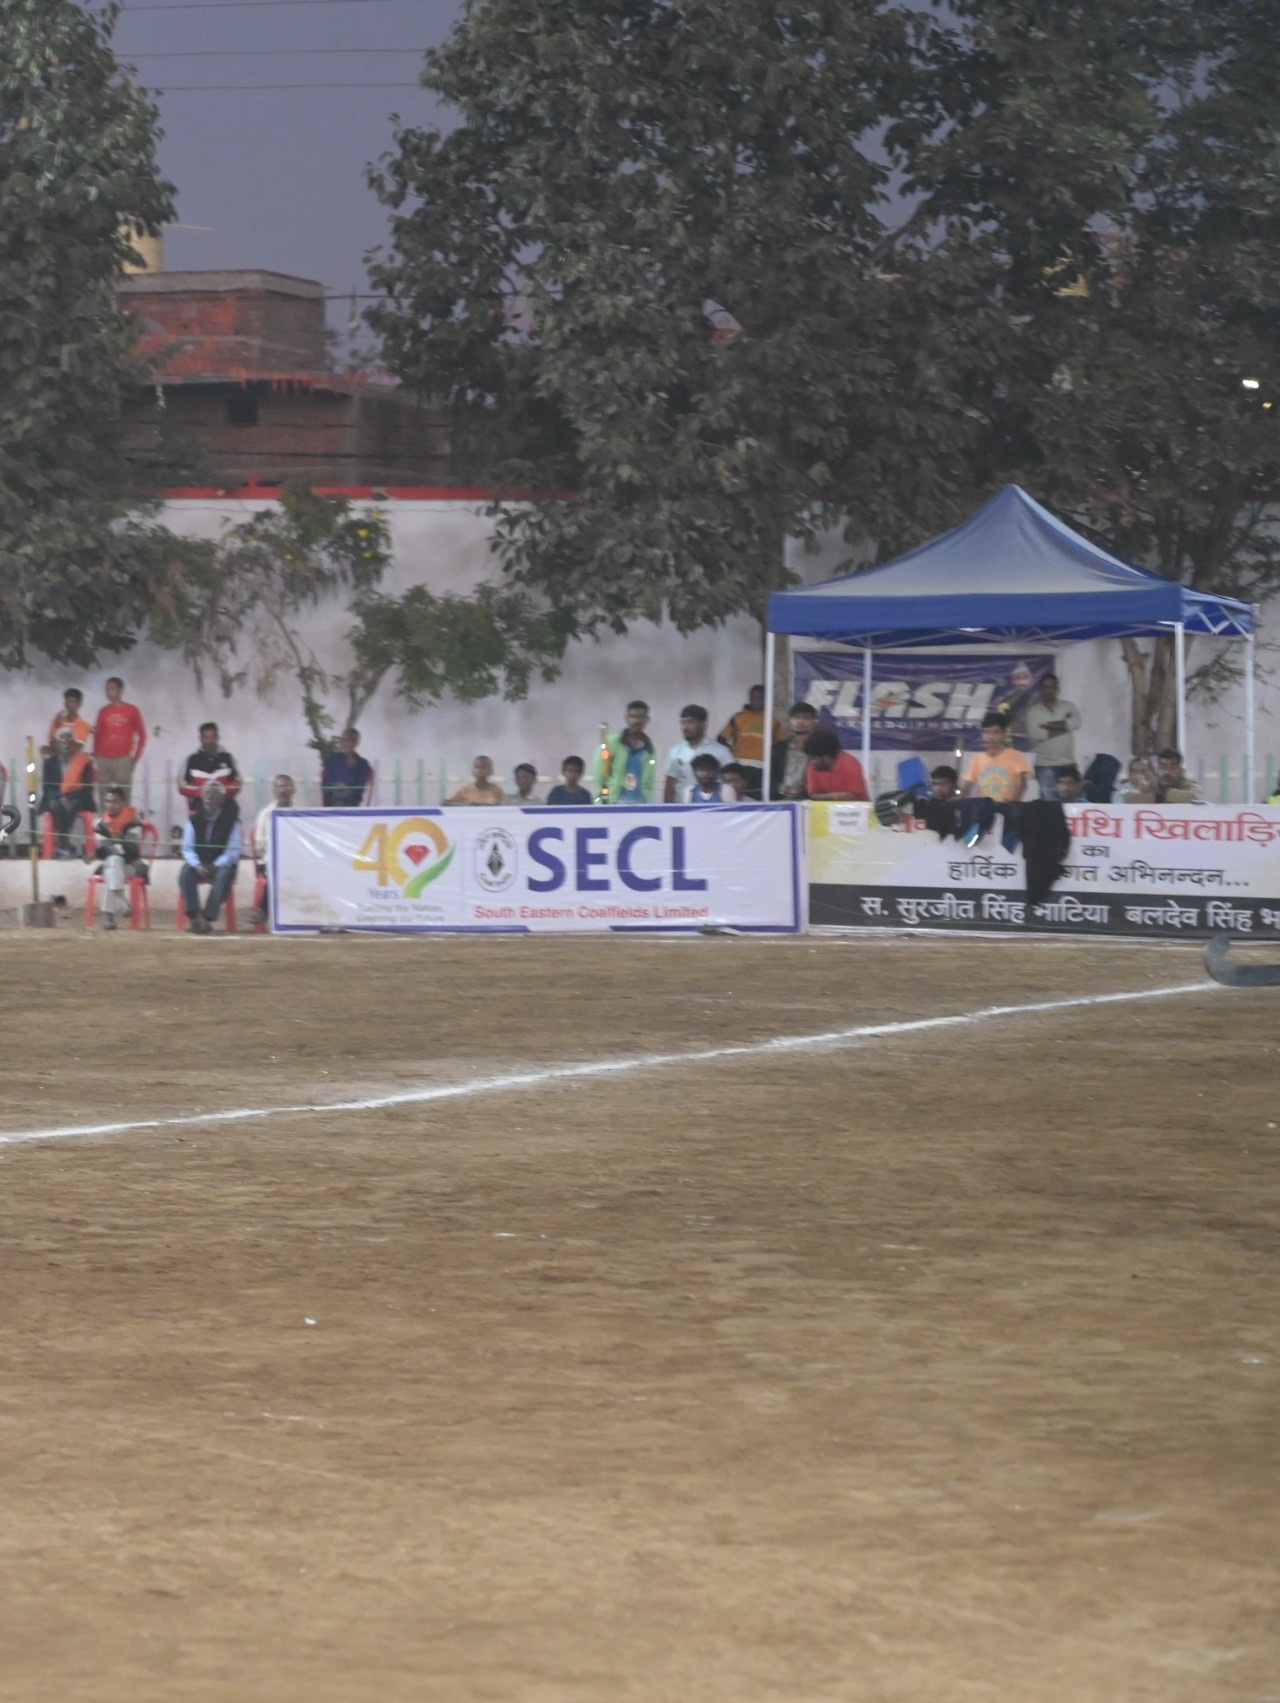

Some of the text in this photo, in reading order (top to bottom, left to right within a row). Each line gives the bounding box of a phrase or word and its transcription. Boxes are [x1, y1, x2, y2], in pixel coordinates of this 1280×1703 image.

[806, 680, 997, 719] FLASH
[1134, 810, 1280, 848] खिलाड़ि
[352, 817, 456, 896] 40
[527, 826, 708, 892] SECL
[948, 855, 1018, 880] हार्दिक
[1081, 845, 1111, 858] का
[367, 888, 400, 899] Years
[475, 906, 515, 919] South
[521, 906, 573, 919] Eastern
[655, 906, 709, 919] Limited
[896, 893, 975, 924] सुरजीत
[981, 893, 1026, 923] सिंह
[1124, 900, 1200, 928] बलदेव
[1206, 901, 1254, 932] सिंह
